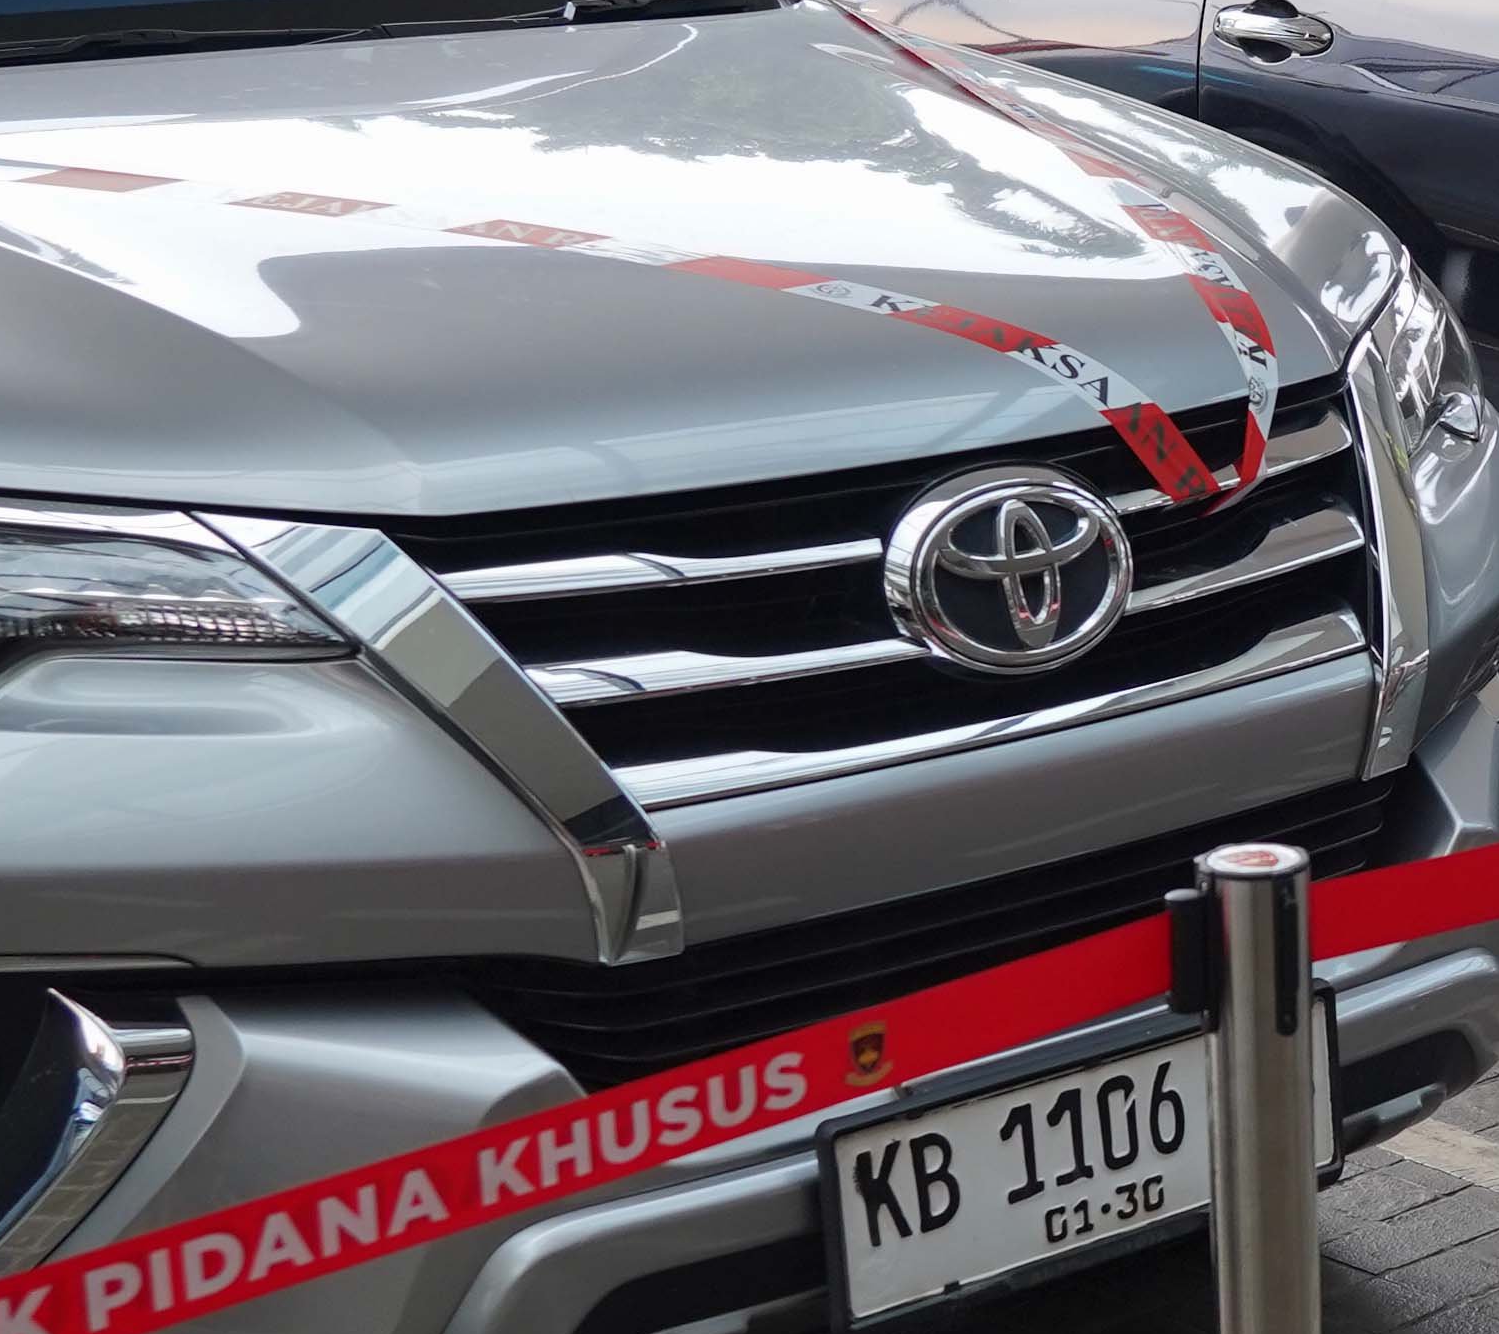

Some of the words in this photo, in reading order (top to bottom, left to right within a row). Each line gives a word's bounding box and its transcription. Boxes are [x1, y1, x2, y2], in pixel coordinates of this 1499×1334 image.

[85, 1173, 452, 1334] PIDANA
[475, 1050, 809, 1208] KHUSUS
[854, 1131, 961, 1248] KB
[999, 1060, 1187, 1205] 1106
